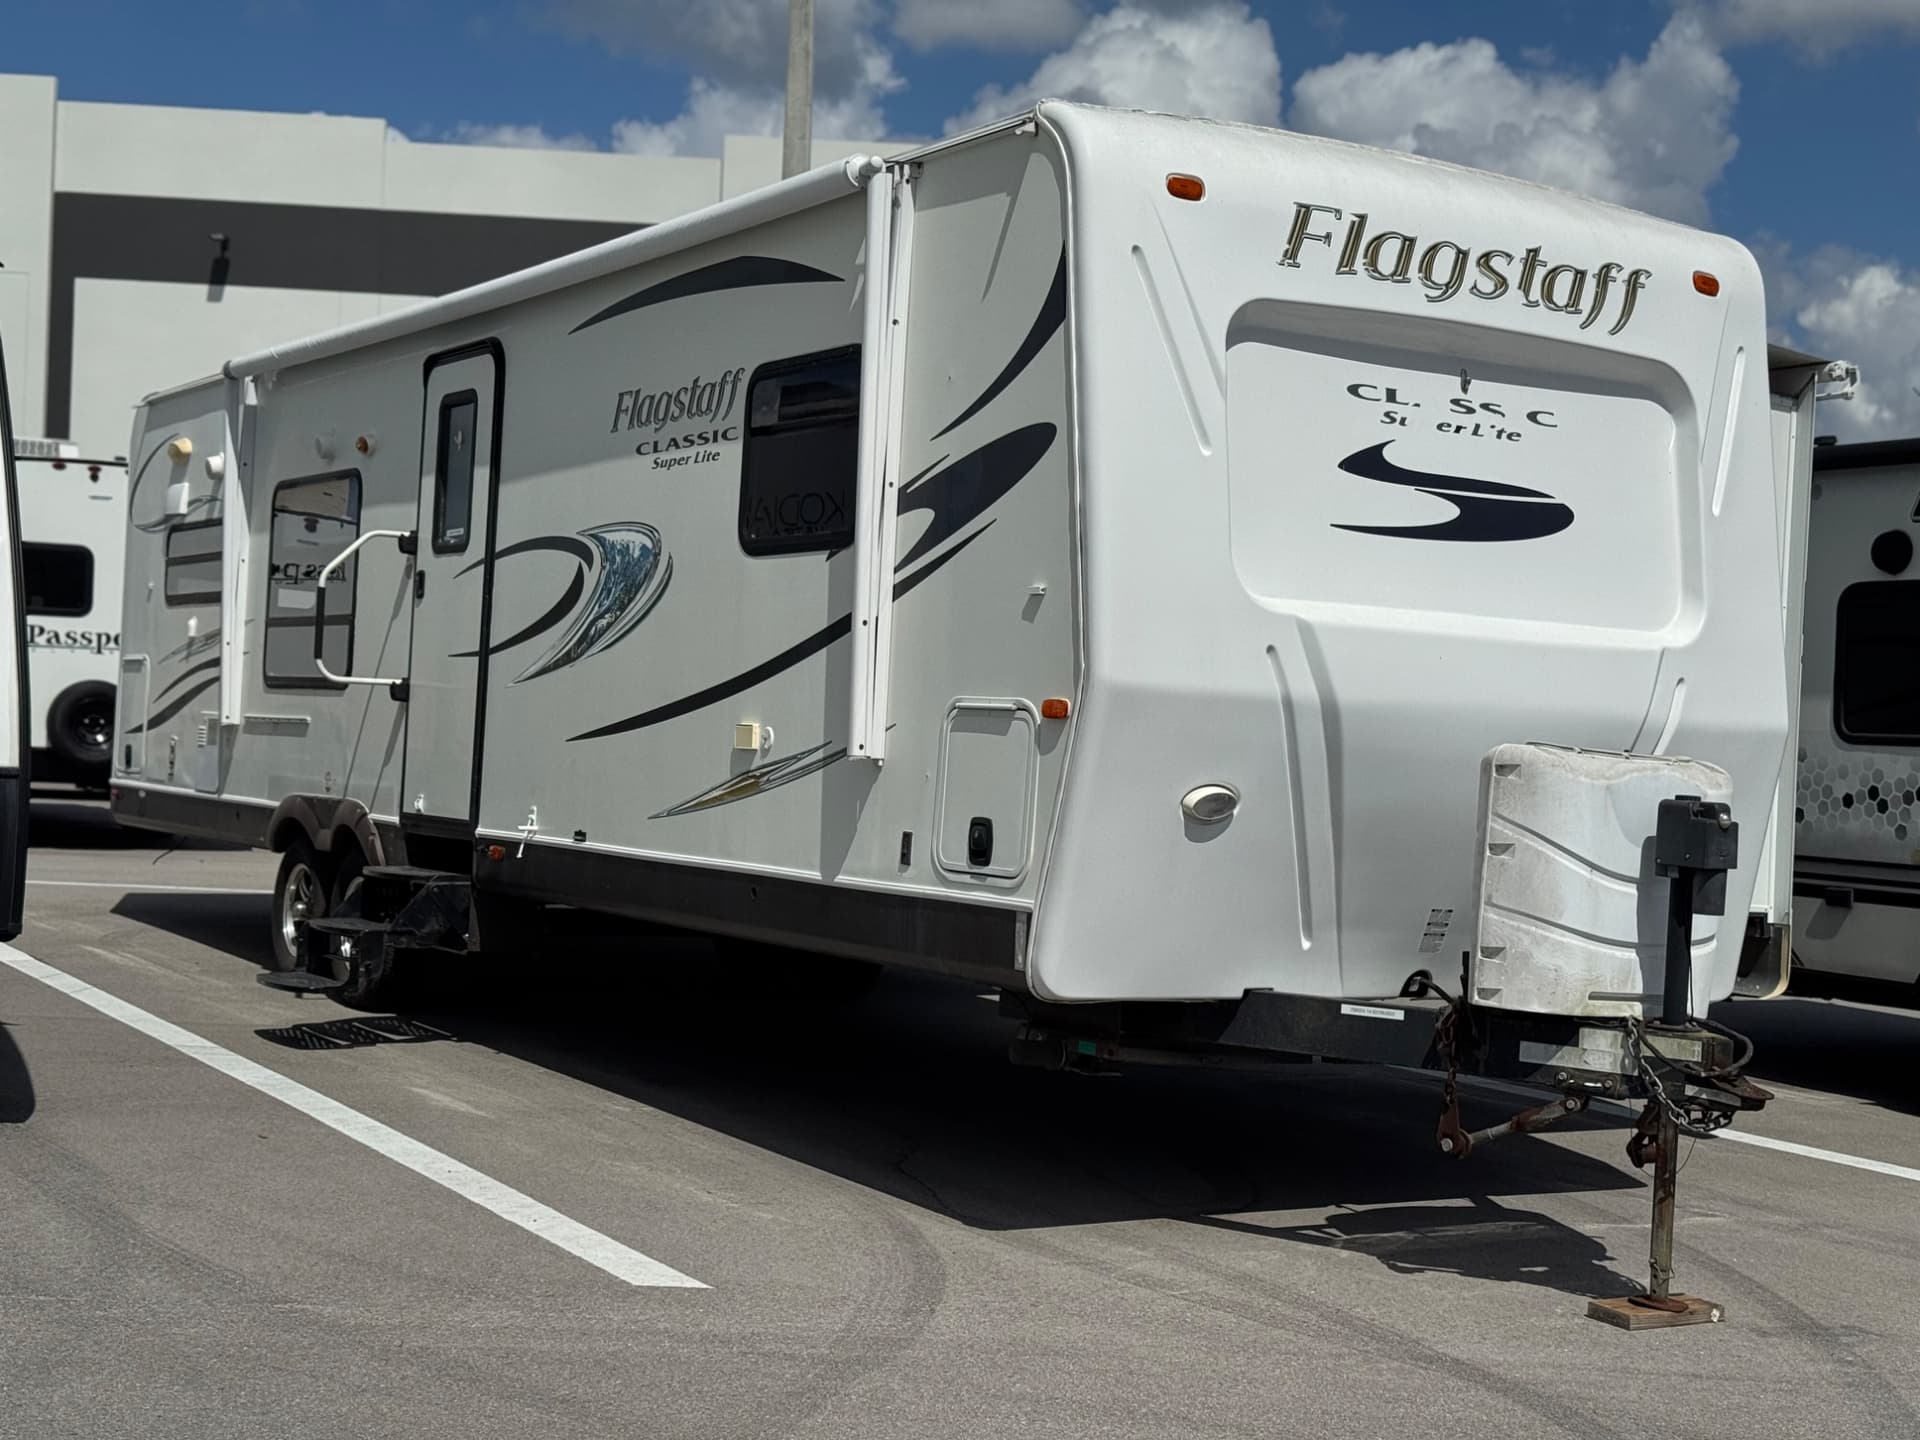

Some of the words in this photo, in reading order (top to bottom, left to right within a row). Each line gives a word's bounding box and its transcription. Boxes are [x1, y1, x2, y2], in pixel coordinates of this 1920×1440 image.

[1276, 201, 1653, 336] Flagstaff
[610, 367, 745, 433] Flagstaff
[1346, 383, 1559, 428] CLSSC
[635, 426, 739, 456] CLASSIC
[1471, 423, 1523, 442] Lte
[651, 455, 692, 470] Super
[693, 449, 721, 464] Lite
